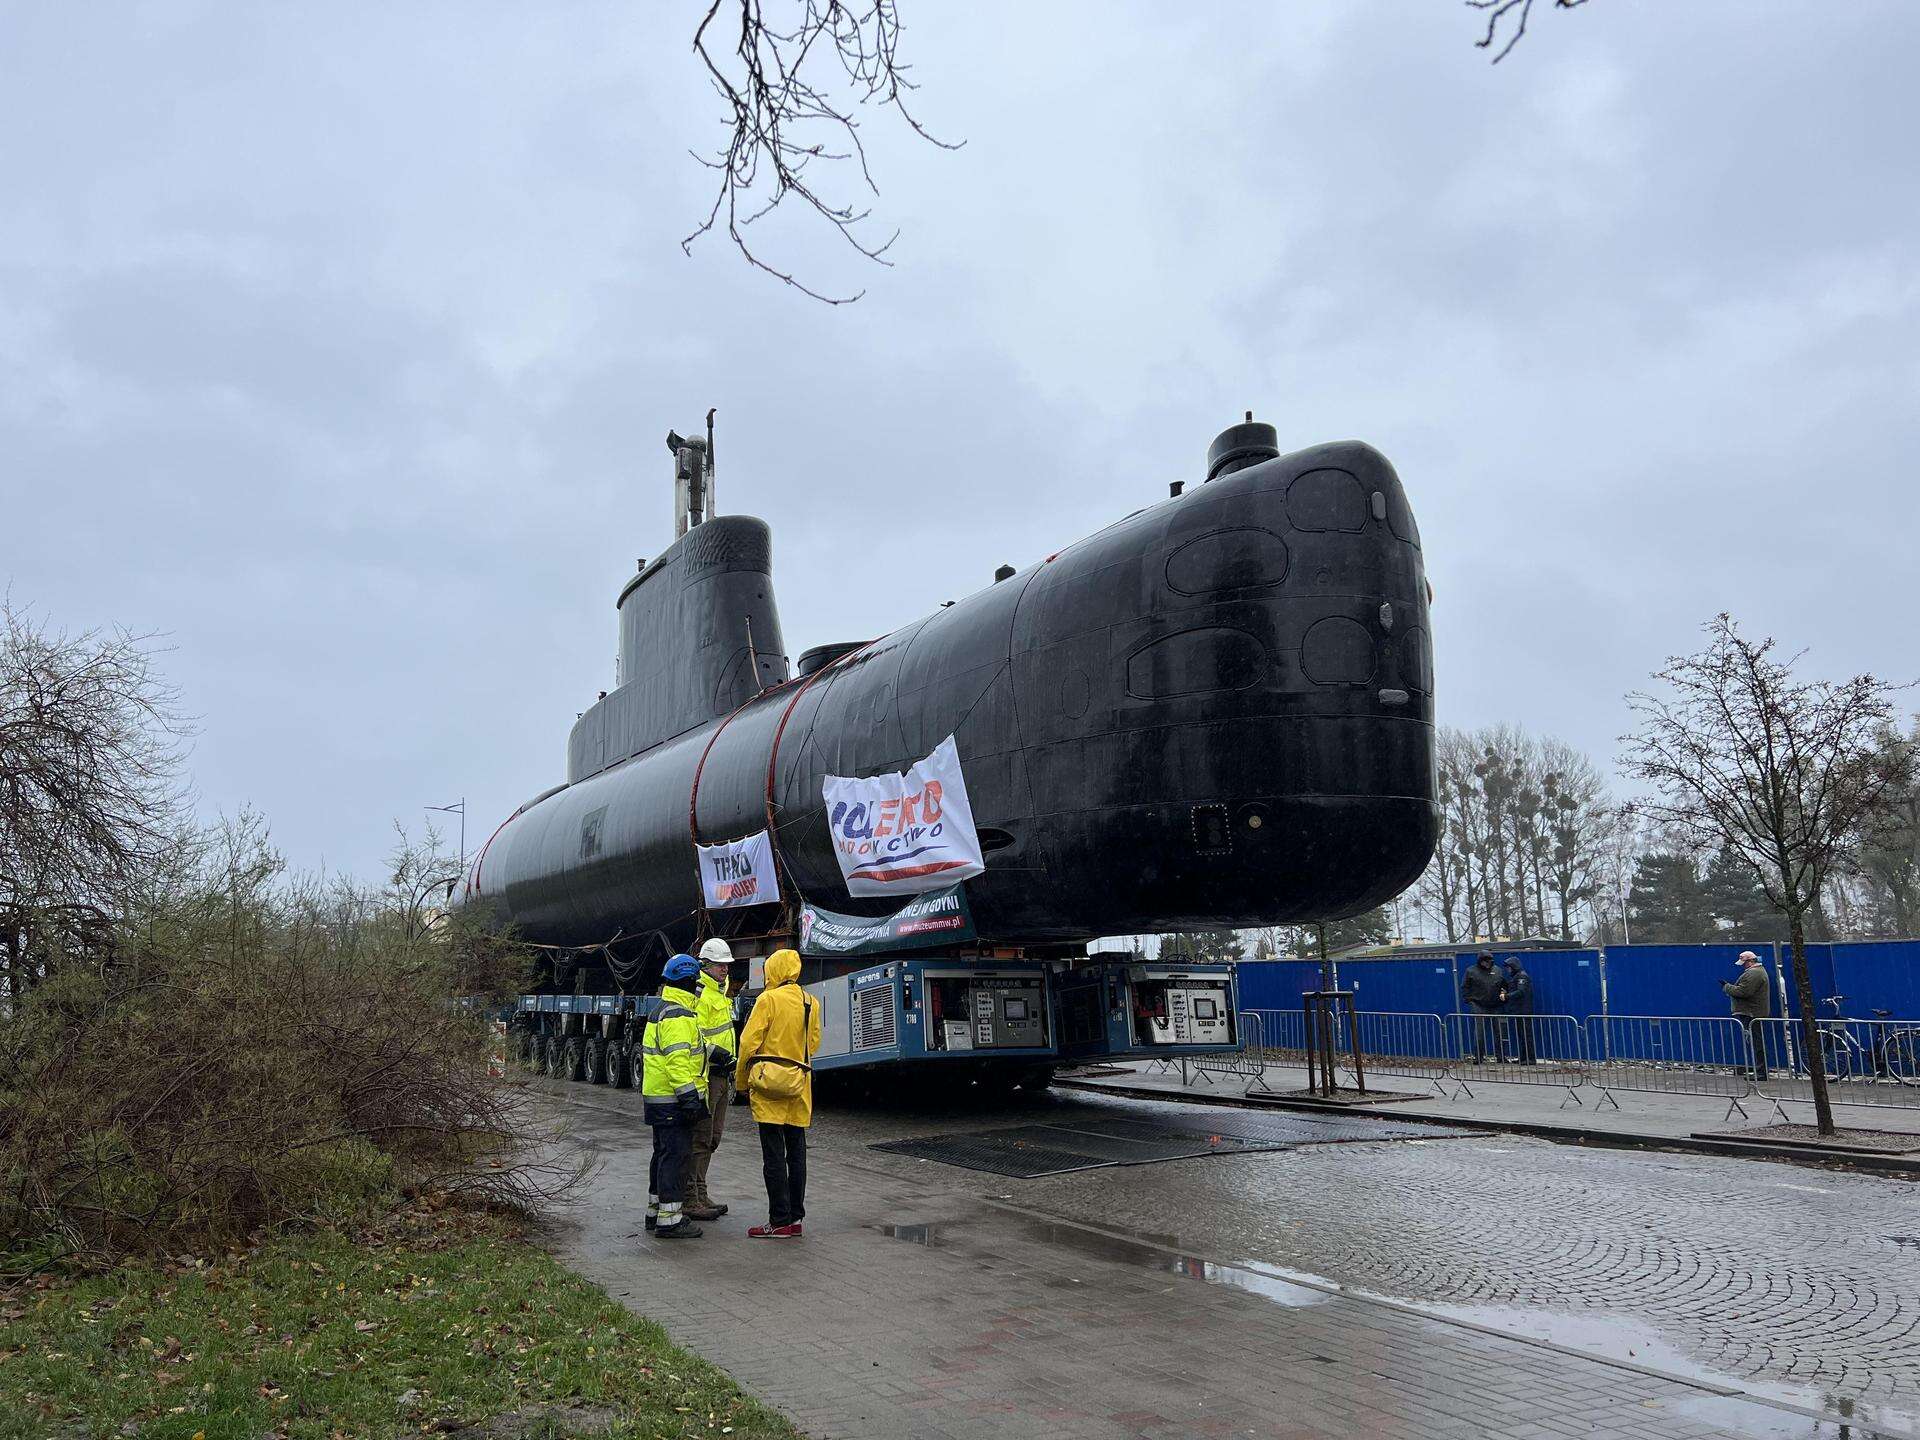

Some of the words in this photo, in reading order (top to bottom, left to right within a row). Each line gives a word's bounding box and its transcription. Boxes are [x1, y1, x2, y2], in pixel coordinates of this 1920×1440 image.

[815, 919, 852, 937] MUZEUM
[929, 895, 960, 913] GDYNI
[898, 916, 961, 934] www.muzeummw.pl
[857, 972, 881, 985] sarens
